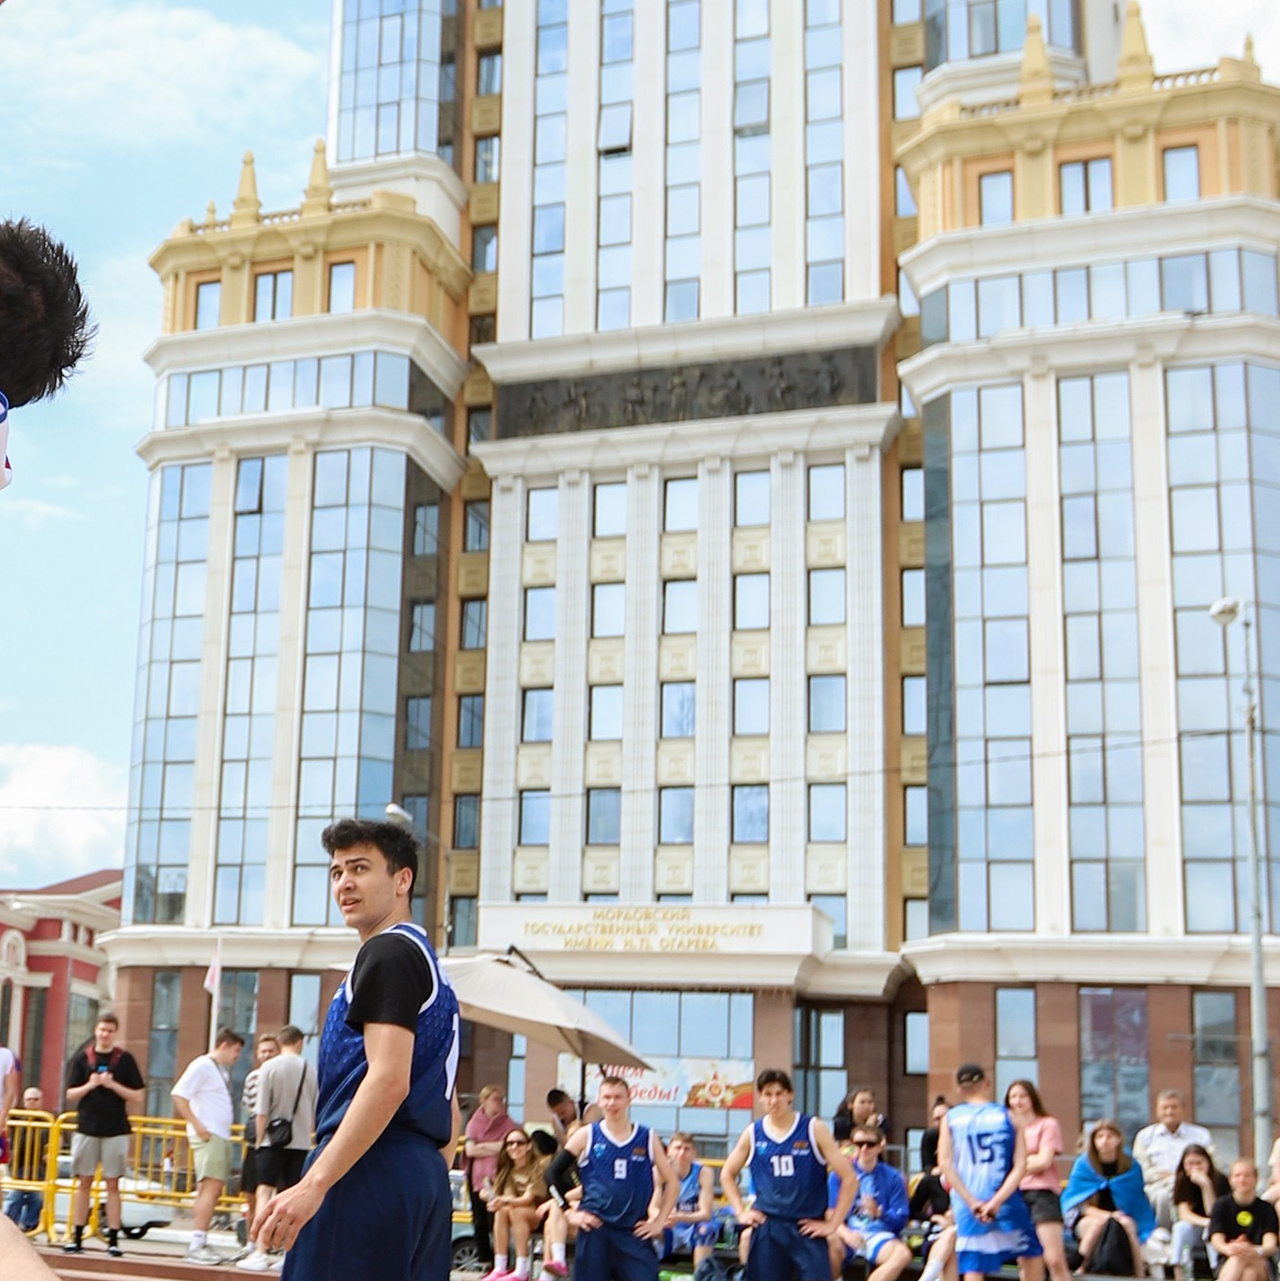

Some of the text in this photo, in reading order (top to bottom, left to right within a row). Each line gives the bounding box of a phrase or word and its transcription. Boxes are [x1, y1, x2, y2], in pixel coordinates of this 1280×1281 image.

[592, 907, 690, 920] МОРДОВСКИЙ
[523, 922, 762, 936] ГОСУДАРСТВЕННЫЙ УНИВЕРСИТЕТ
[967, 1132, 995, 1165] 15
[614, 1158, 628, 1180] 9
[770, 1155, 795, 1177] 10
